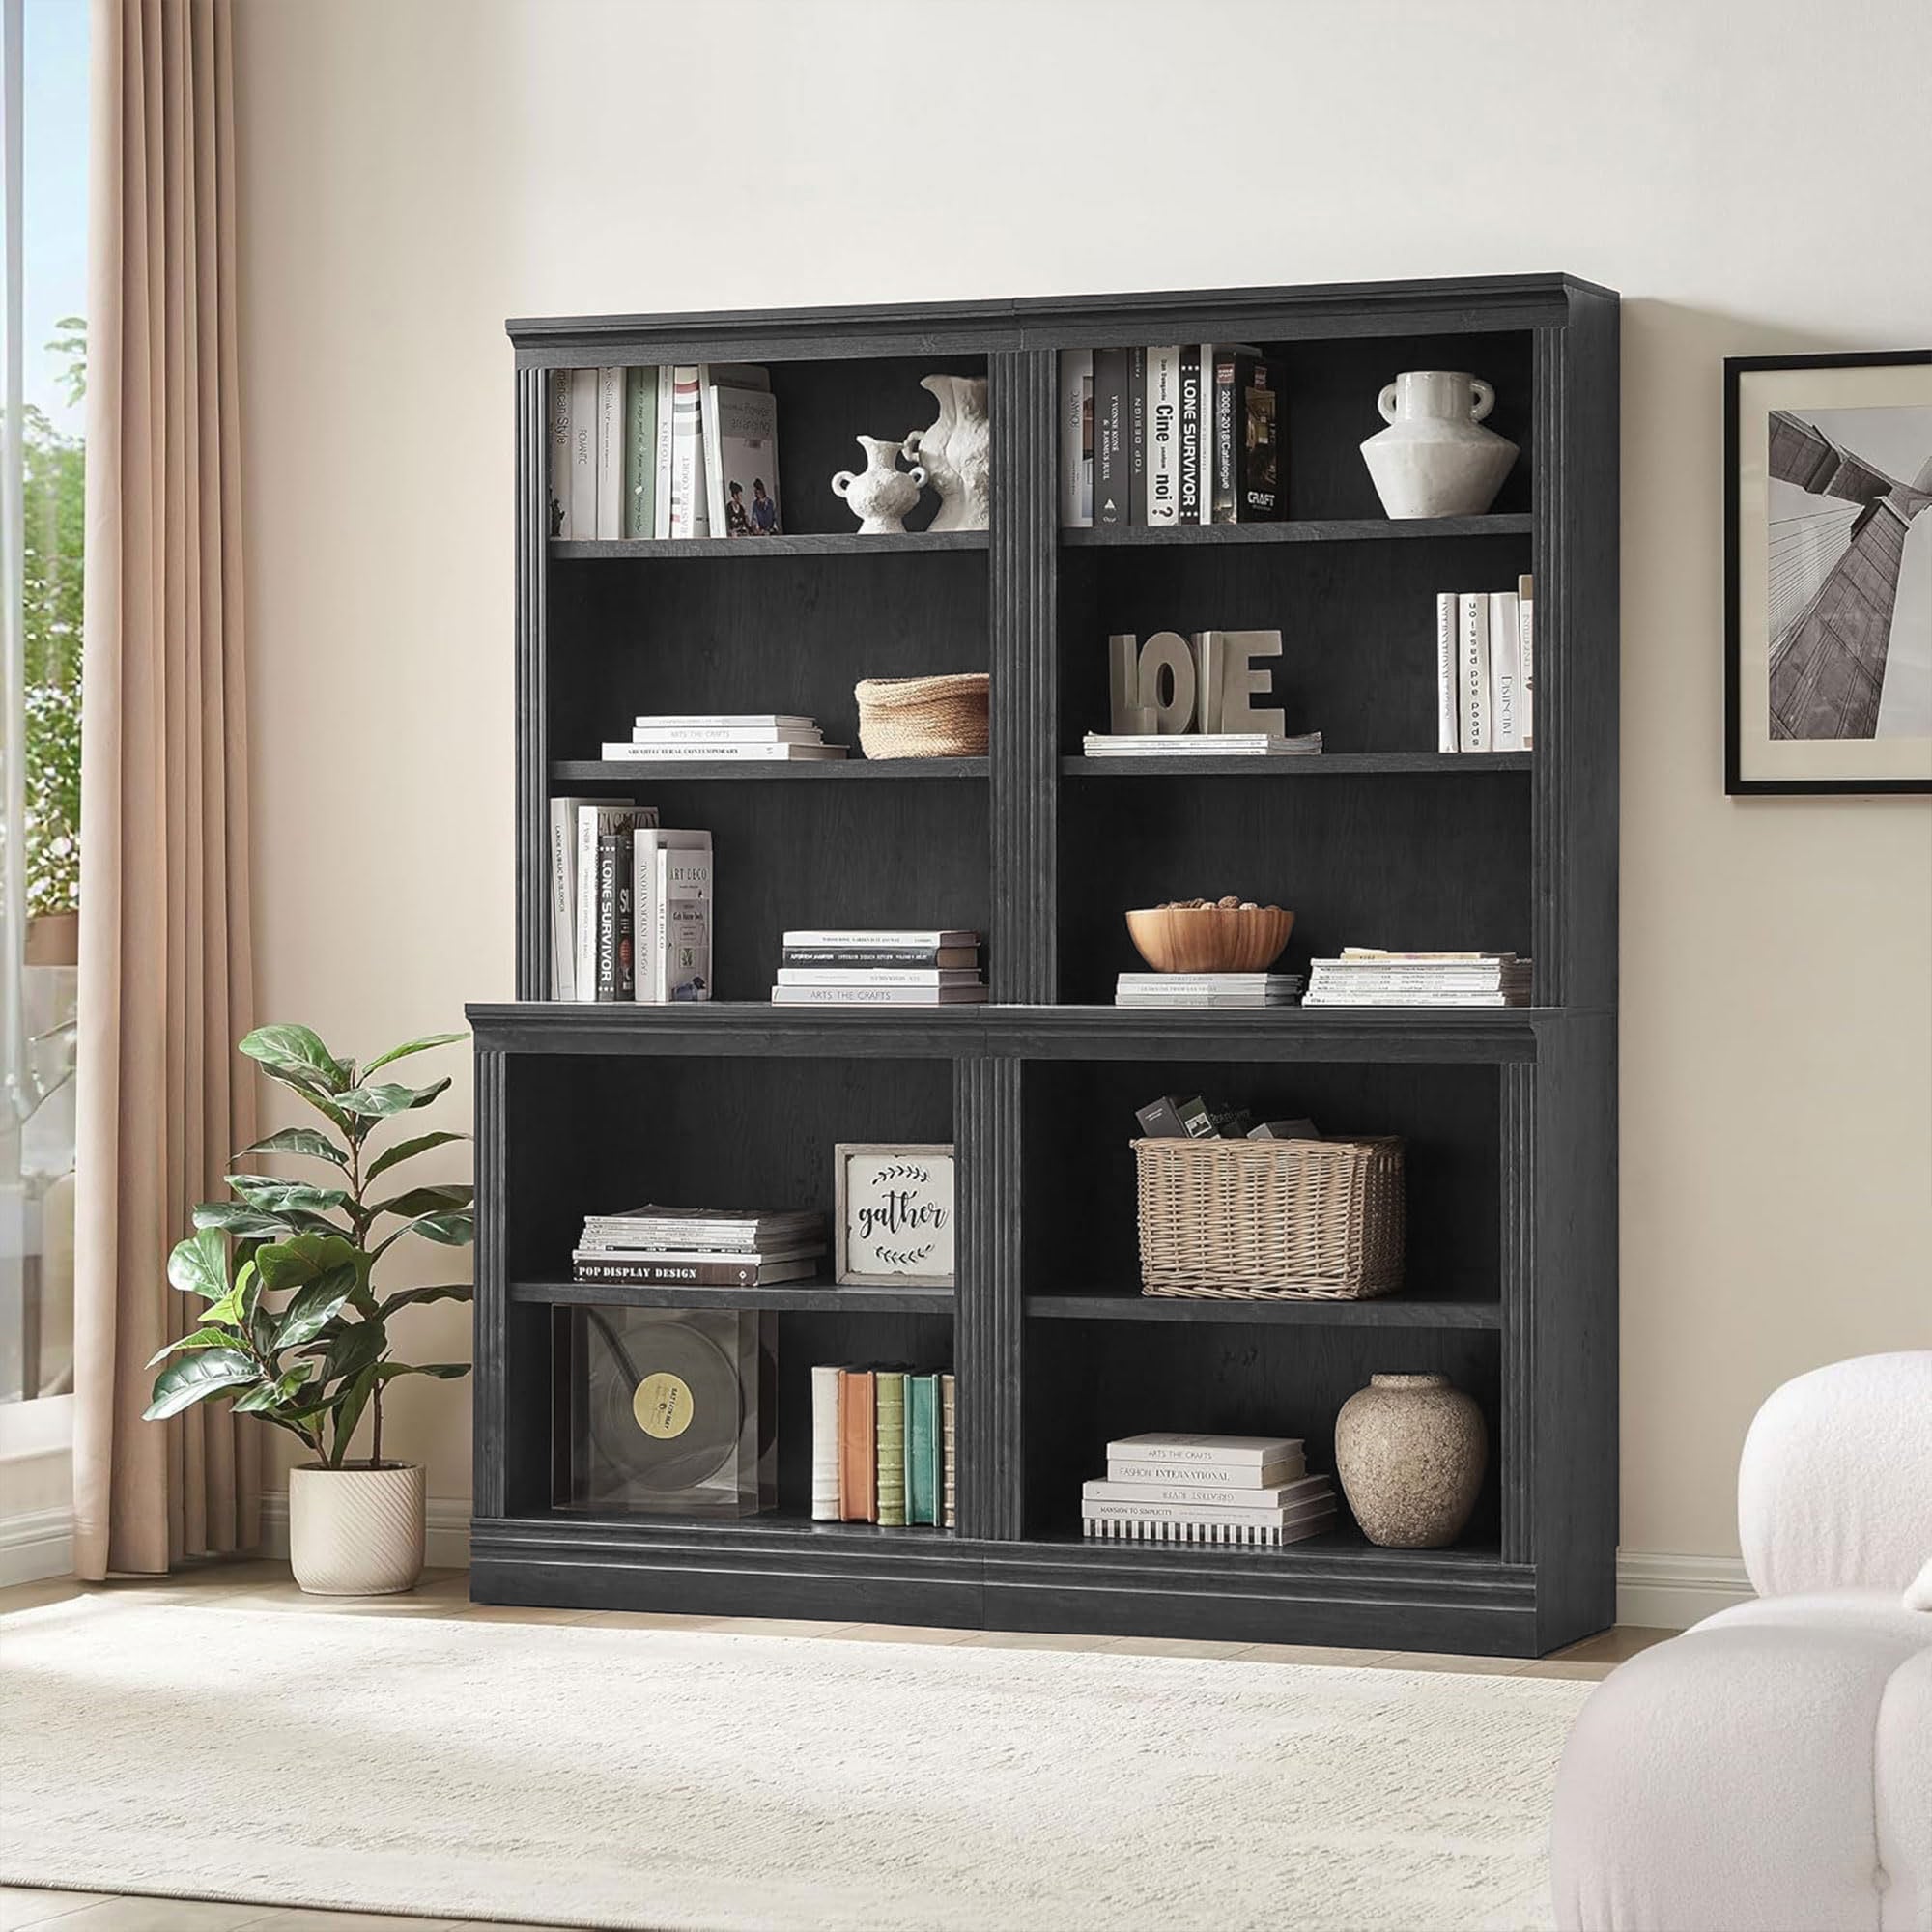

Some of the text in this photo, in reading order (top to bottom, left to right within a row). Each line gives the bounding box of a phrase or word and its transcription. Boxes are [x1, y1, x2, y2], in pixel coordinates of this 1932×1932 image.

[555, 370, 569, 444] merican Style
[1156, 404, 1174, 441] Cine
[660, 422, 668, 472] KINFOLK
[1182, 378, 1197, 507] LONE SURVIVOR
[1155, 474, 1174, 501] noi
[1247, 491, 1275, 507] CRAFT
[1469, 602, 1480, 746] speed and passion
[669, 867, 707, 880] ART DECO
[639, 862, 648, 937] INTERNATIONAL
[601, 859, 613, 982] LONE SURVIVOR
[810, 990, 891, 1000] ARTS THE CRAFTS
[857, 1190, 948, 1239] gather
[579, 1266, 696, 1278] POP DISPLAY DESIGN
[1148, 1450, 1212, 1461] ARTS THE CRAFTS
[1120, 1467, 1231, 1482] FASHION INTERNATIONAL
